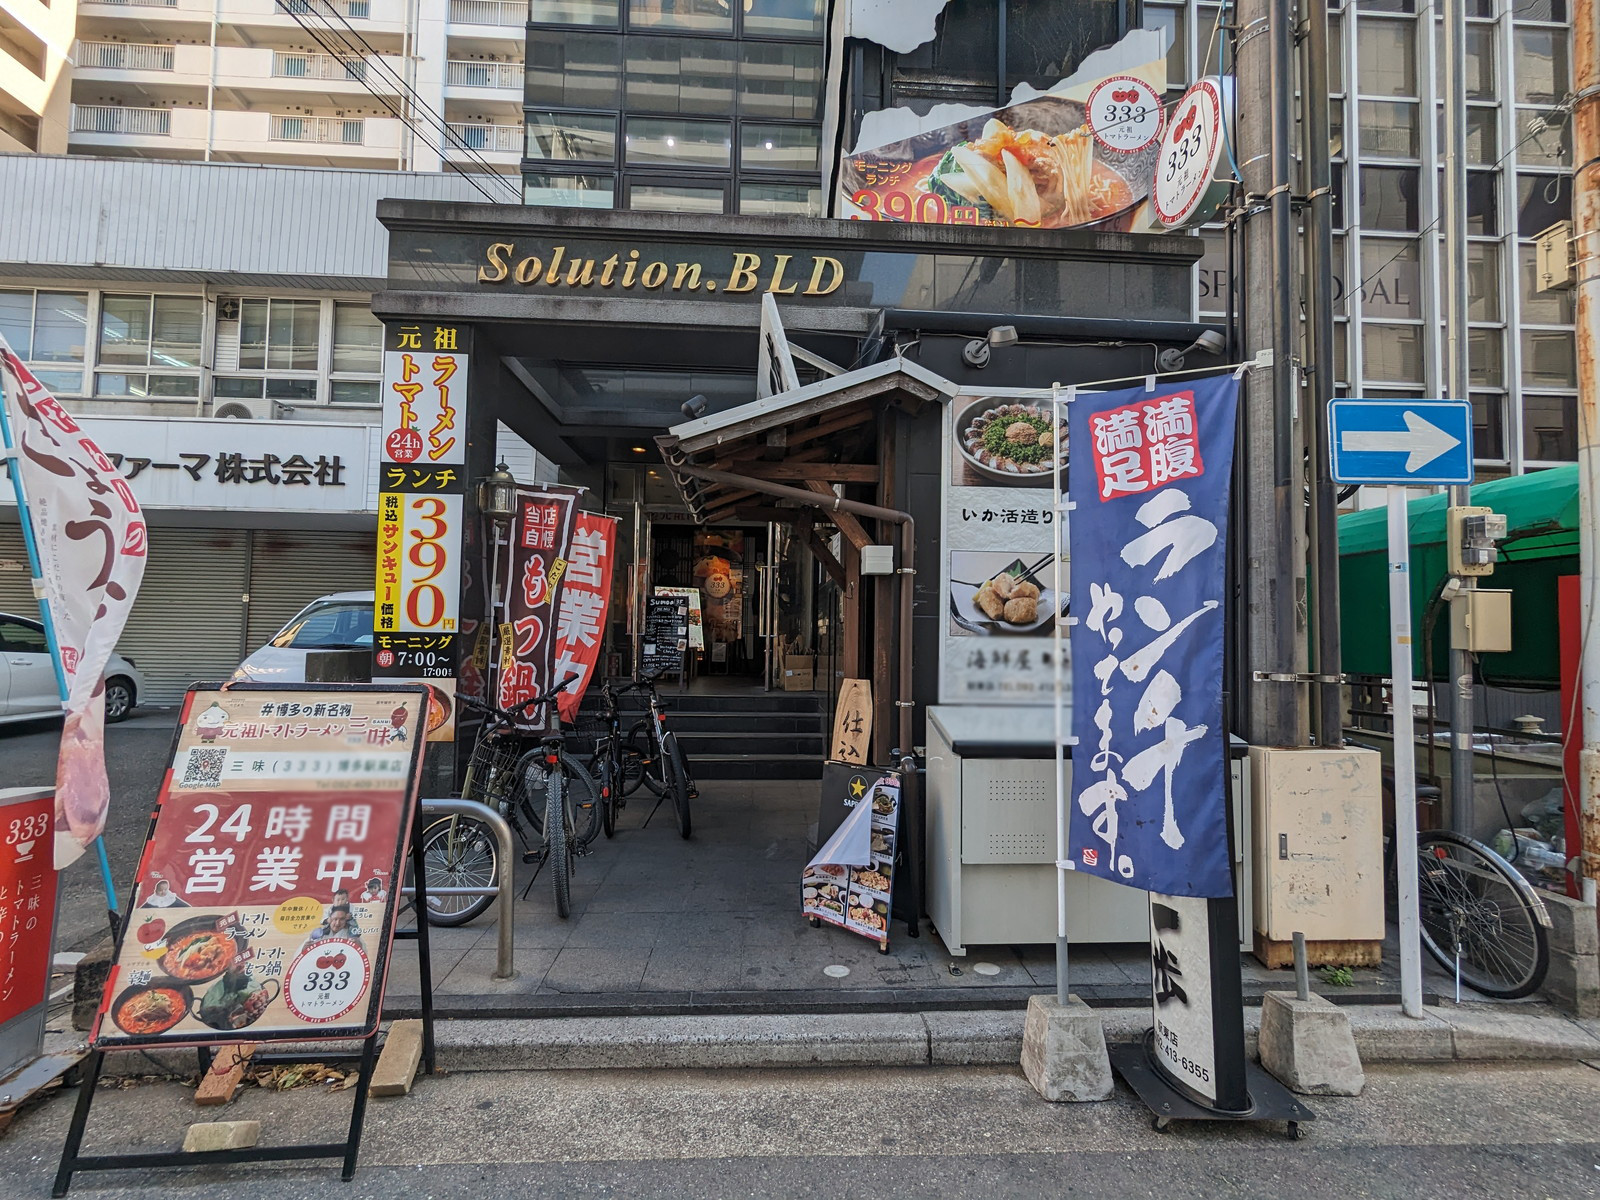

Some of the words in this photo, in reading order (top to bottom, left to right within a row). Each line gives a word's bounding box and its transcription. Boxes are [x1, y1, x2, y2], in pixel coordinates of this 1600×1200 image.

[1104, 104, 1146, 123] 333
[1104, 133, 1149, 141] トマトラーメン
[1166, 124, 1202, 182] 333
[855, 160, 912, 174] モーニング
[866, 174, 900, 185] ランチ
[478, 242, 845, 295] Solution.BLD
[397, 326, 458, 350] 元祖
[392, 354, 424, 429] トマト
[428, 355, 458, 461] ラーメン
[391, 432, 421, 449] 24h
[1143, 396, 1197, 477] 満腹
[394, 450, 413, 459] 営業
[1094, 409, 1149, 498] 満足
[387, 468, 457, 489] ランチ
[526, 505, 557, 525] 当店
[961, 508, 1054, 525] いか活造り
[381, 496, 399, 629] 税込サンキュー価格
[378, 635, 453, 650] モーニング
[499, 554, 547, 720] もつ鍋
[379, 652, 393, 665] 朝
[1119, 488, 1221, 850] ランチ
[179, 782, 204, 790] Google
[6, 813, 49, 845] 333
[185, 803, 372, 843] 24時間
[185, 845, 364, 894] 営業中
[26, 874, 42, 930] 三味の
[218, 914, 237, 927] 元祖
[240, 912, 270, 926] トマト
[2, 879, 24, 1001] トマトラーメン
[224, 926, 268, 939] ラーメン
[233, 951, 252, 964] 元祖
[256, 946, 286, 959] トマト
[245, 961, 282, 976] もつ鍋
[303, 970, 351, 992] 333
[301, 1000, 345, 1008] トマトラーメン
[317, 992, 330, 1000] 元祖
